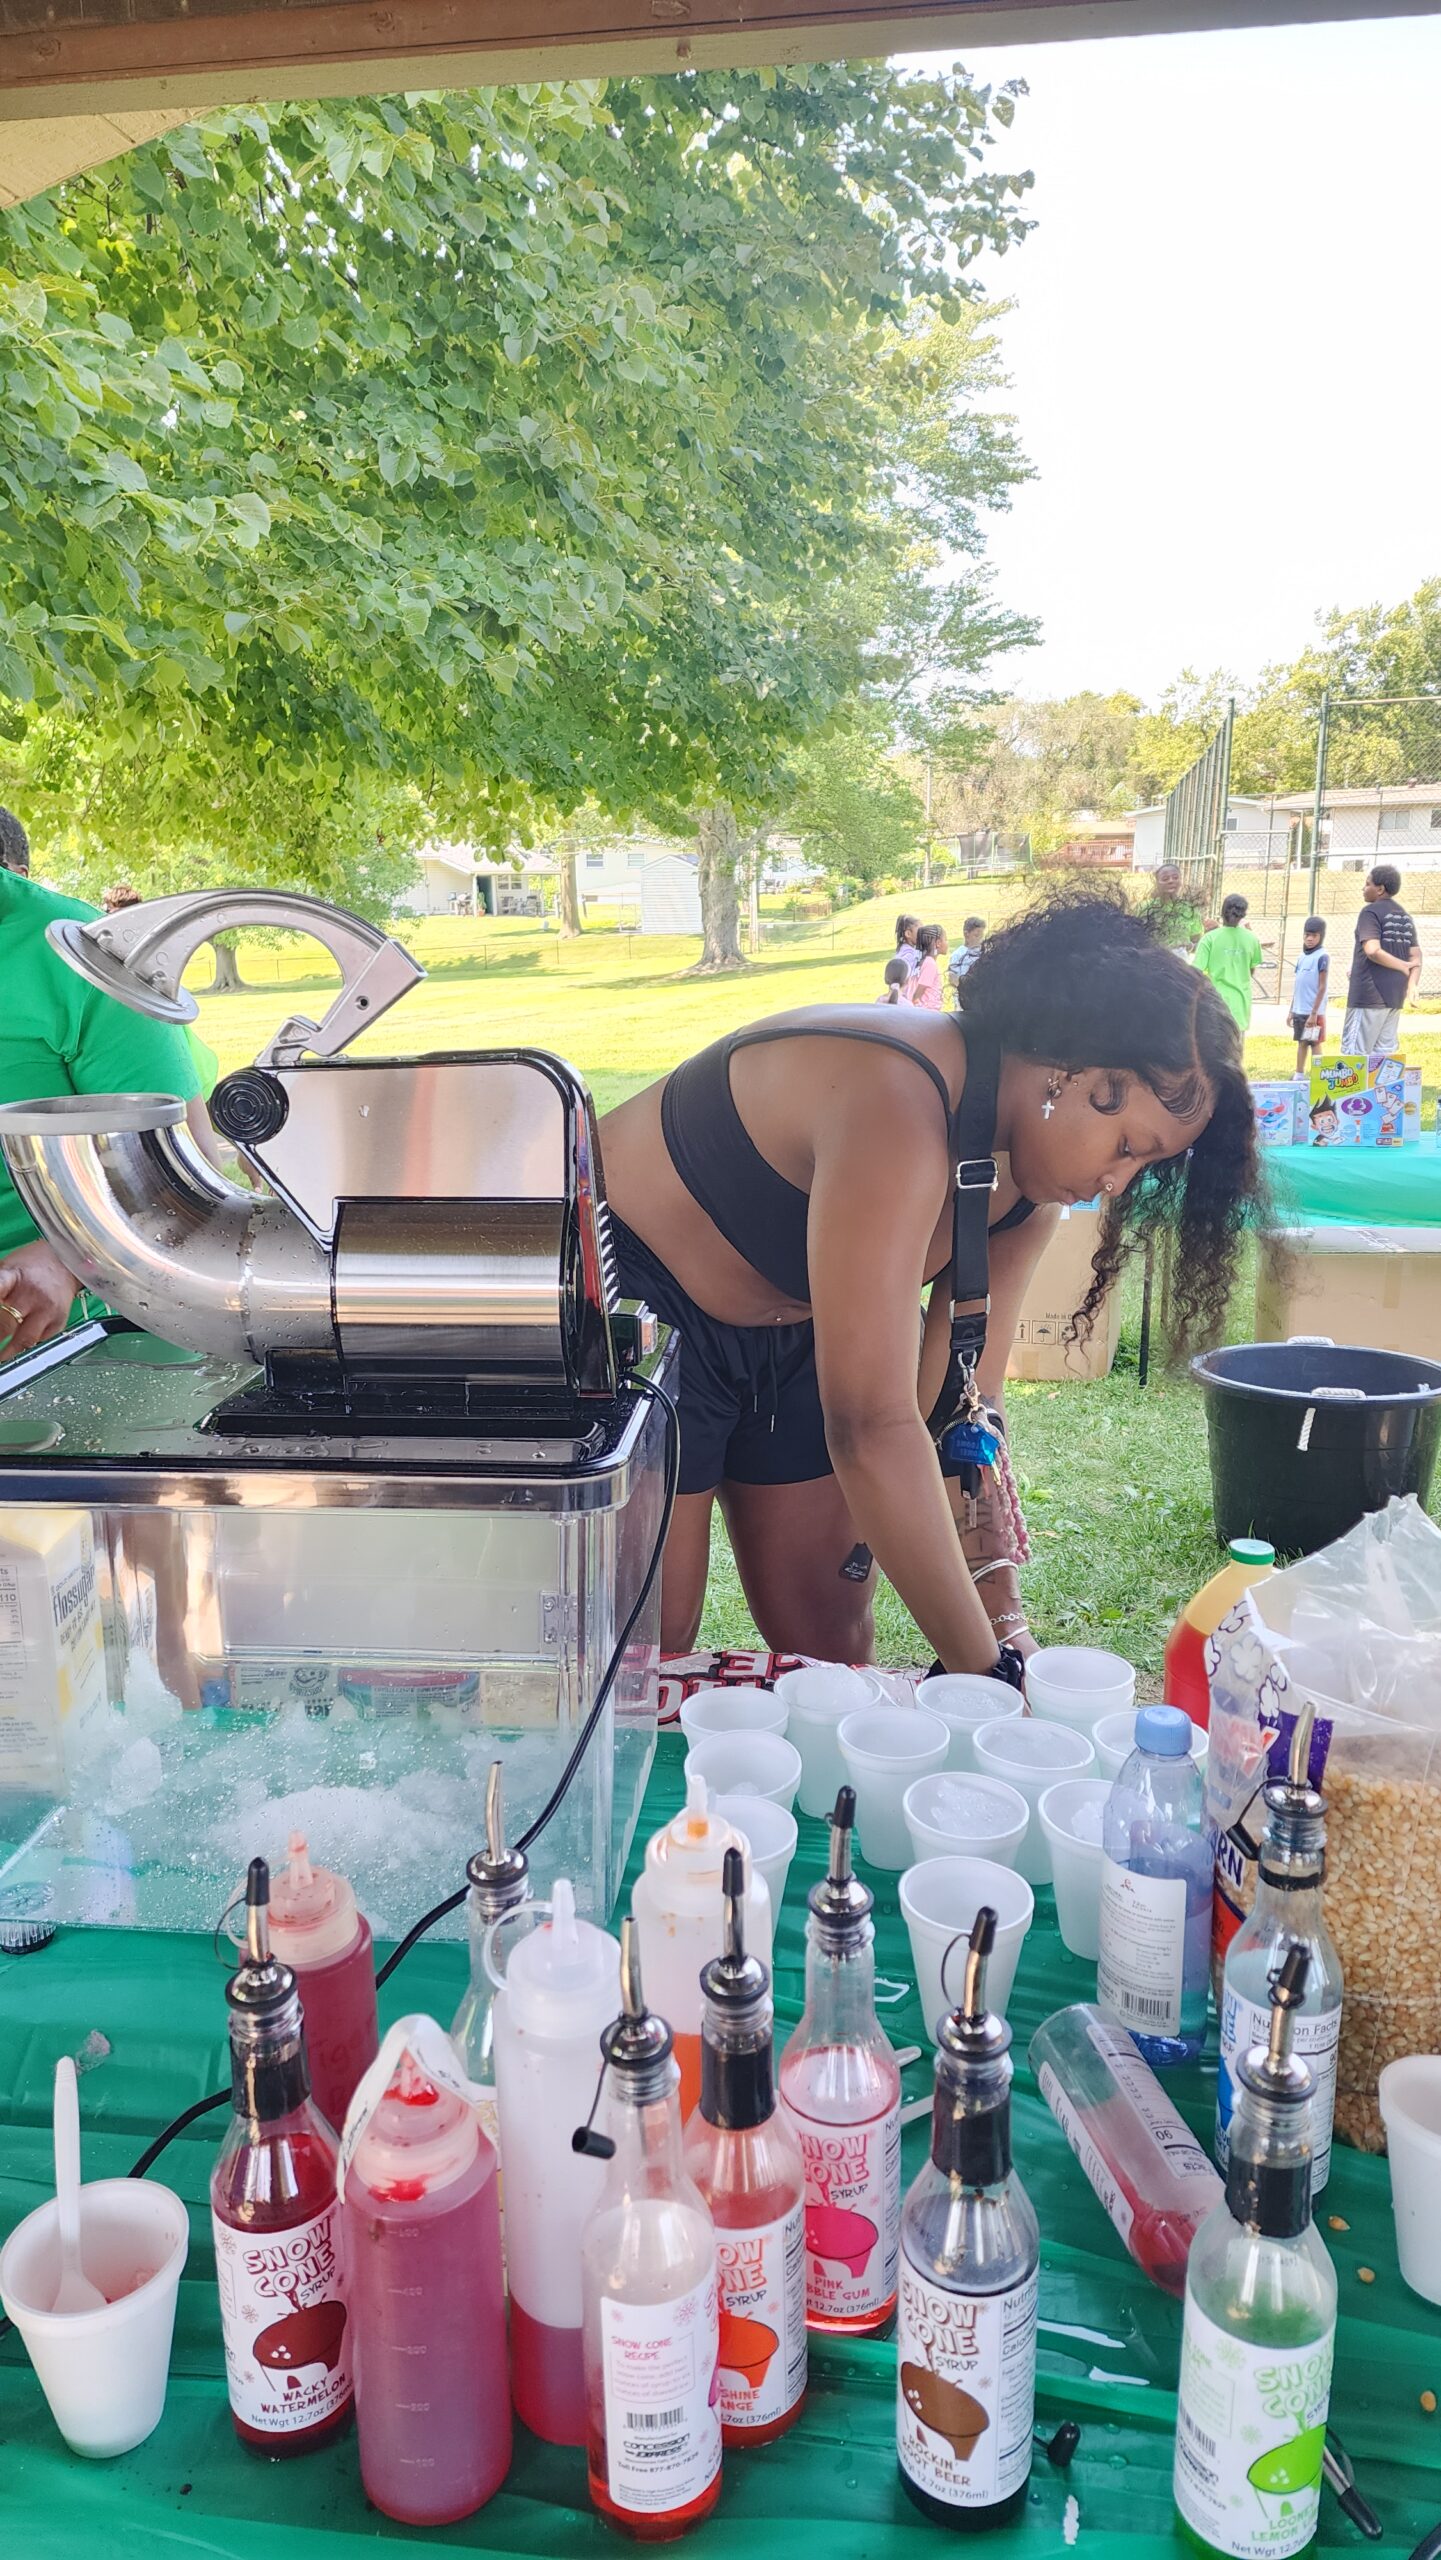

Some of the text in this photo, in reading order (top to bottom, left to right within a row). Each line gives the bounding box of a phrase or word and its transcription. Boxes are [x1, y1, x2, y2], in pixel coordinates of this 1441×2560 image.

[1320, 1068, 1354, 1081] MUMBO
[1328, 1073, 1359, 1090] JUMBO
[1045, 1312, 1059, 1320] Made
[1313, 2018, 1338, 2035] Facts
[1155, 2129, 1173, 2142] 90
[798, 2129, 868, 2162] NOW
[831, 2184, 869, 2200] SYRUP
[242, 2215, 332, 2275] SNOW
[716, 2238, 764, 2267] OW
[254, 2239, 336, 2298] CONE
[300, 2265, 336, 2301] SYRUP
[815, 2277, 843, 2290] PINK
[726, 2290, 768, 2307] SYRUP
[843, 2288, 870, 2301] GUM
[901, 2272, 978, 2330] SNOW
[814, 2300, 845, 2314] 12.7oz
[904, 2306, 980, 2357] CONE
[610, 2335, 673, 2350] SNOW CONE
[935, 2356, 979, 2371] SYRUP
[260, 2373, 346, 2414] WATERMELON
[282, 2376, 328, 2402] WACKY
[251, 2413, 268, 2426] Net
[269, 2418, 290, 2428] Wgt
[293, 2408, 325, 2425] 12.7oz
[746, 2406, 782, 2424] (376ml)
[631, 2465, 649, 2473] Free
[935, 2467, 972, 2487] BEER
[917, 2470, 946, 2493] 12.7oz
[949, 2487, 990, 2500] (376ml)
[1251, 2526, 1297, 2542] LEMON
[1232, 2540, 1251, 2555] Net
[1254, 2546, 1276, 2558] Wgt
